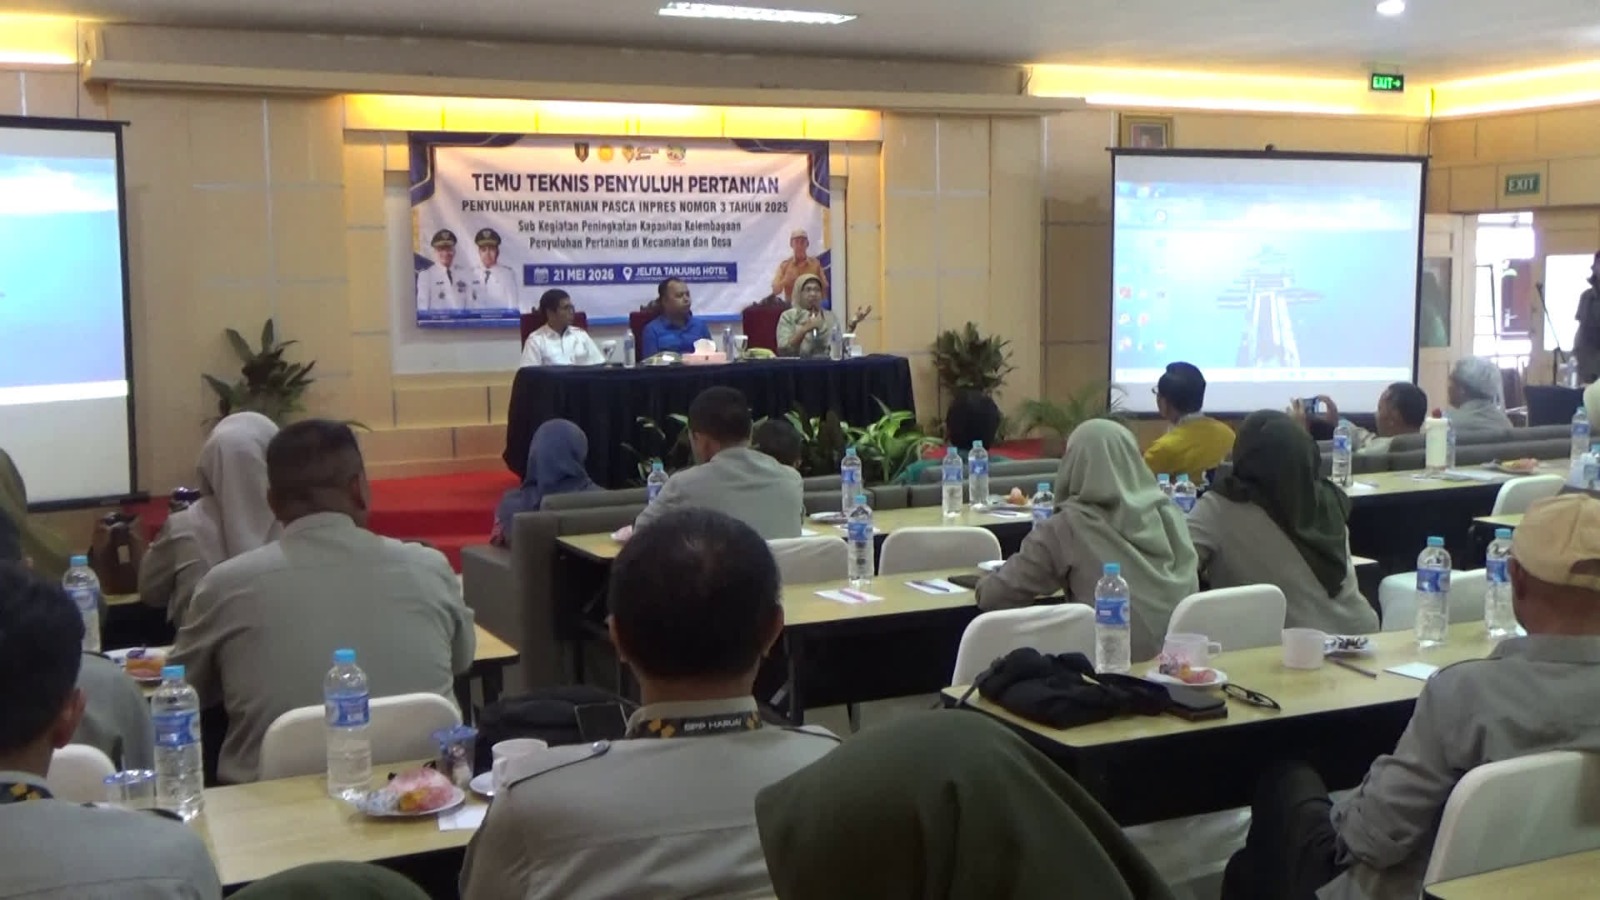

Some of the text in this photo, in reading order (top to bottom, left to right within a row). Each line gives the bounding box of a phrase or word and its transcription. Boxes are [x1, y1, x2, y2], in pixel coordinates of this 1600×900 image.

[1372, 76, 1393, 89] EXIT
[471, 173, 779, 194] TEMU TEKNIS PENYULUH PERTANIAN
[1508, 178, 1535, 192] EXIT
[462, 200, 788, 213] PENYULUHAN PERTANIAN PASCA INPRES NOMOR 3 TAHUN 2025
[518, 220, 742, 235] Sub Kegiatan Peningkatan Kapasitas Kelembagaan
[529, 237, 732, 250] Penyuluhan Pertanian di Kecamatan dan Desa
[553, 268, 615, 281] 21 MEI 2026
[634, 266, 728, 277] JELITA TANJUNG HOTEL
